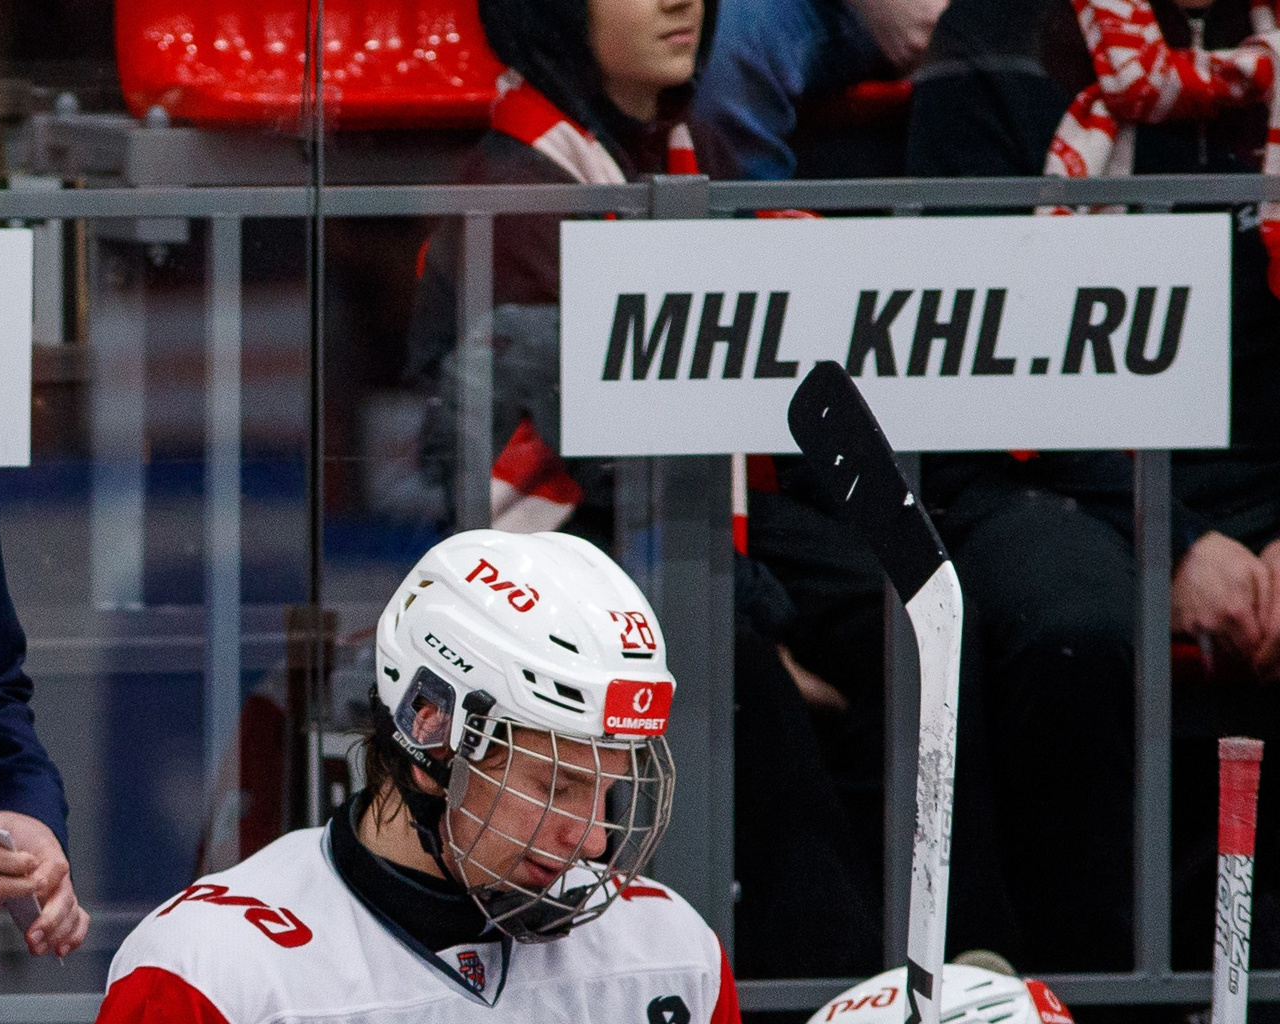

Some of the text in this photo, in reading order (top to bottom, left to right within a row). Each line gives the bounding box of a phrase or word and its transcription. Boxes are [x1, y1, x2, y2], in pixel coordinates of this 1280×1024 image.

[602, 286, 1190, 380] MHLKHL.RU
[607, 609, 657, 650] 28
[423, 632, 474, 674] CCM
[606, 715, 666, 730] OLIMPBET
